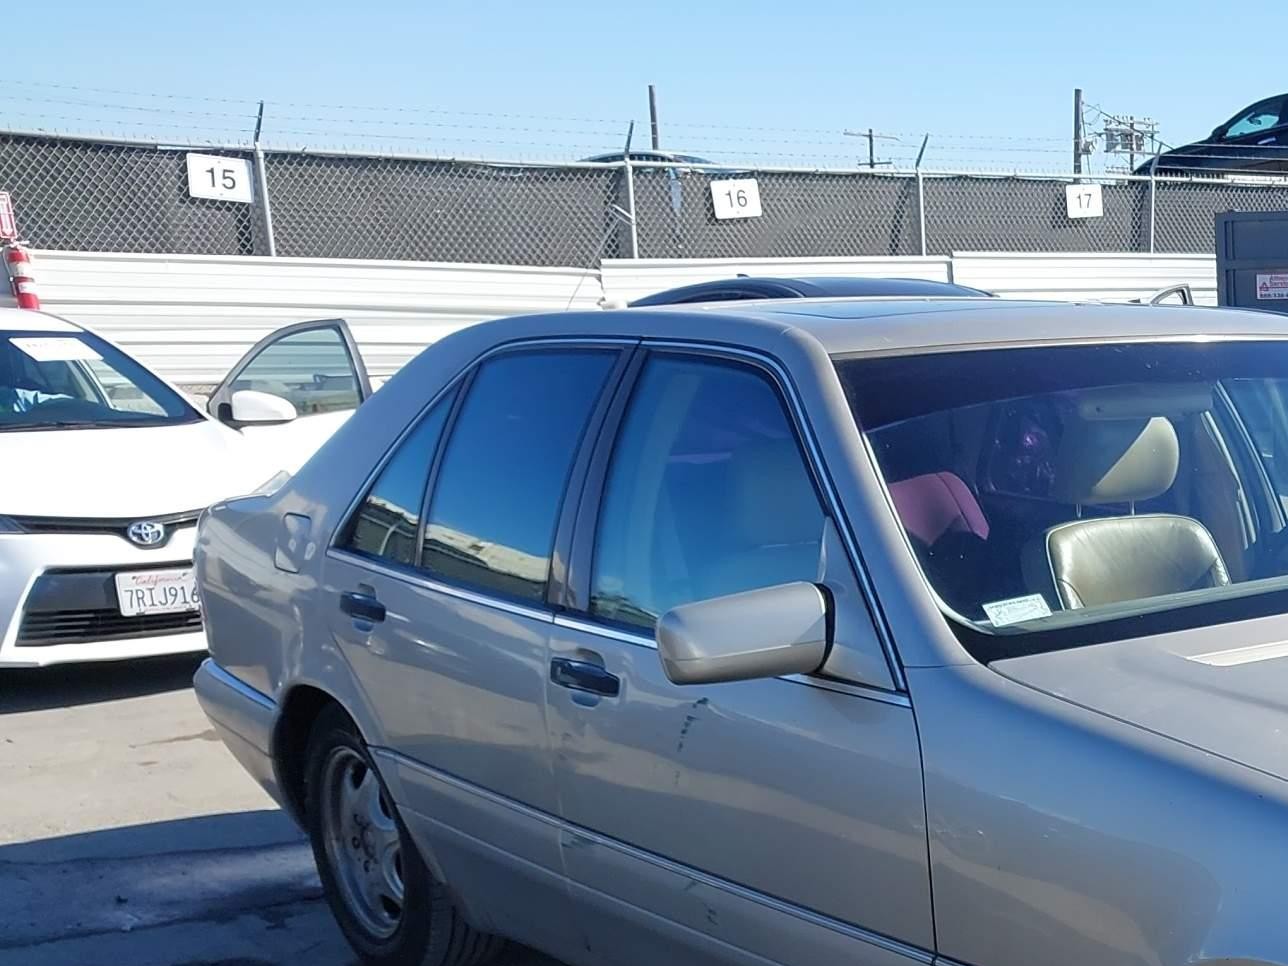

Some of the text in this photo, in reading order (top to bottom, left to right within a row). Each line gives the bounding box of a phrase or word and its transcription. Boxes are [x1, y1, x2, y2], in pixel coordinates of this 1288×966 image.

[205, 167, 236, 190] 15
[725, 189, 748, 208] 16
[1076, 193, 1092, 209] 17
[124, 586, 200, 609] 7RIJ916
